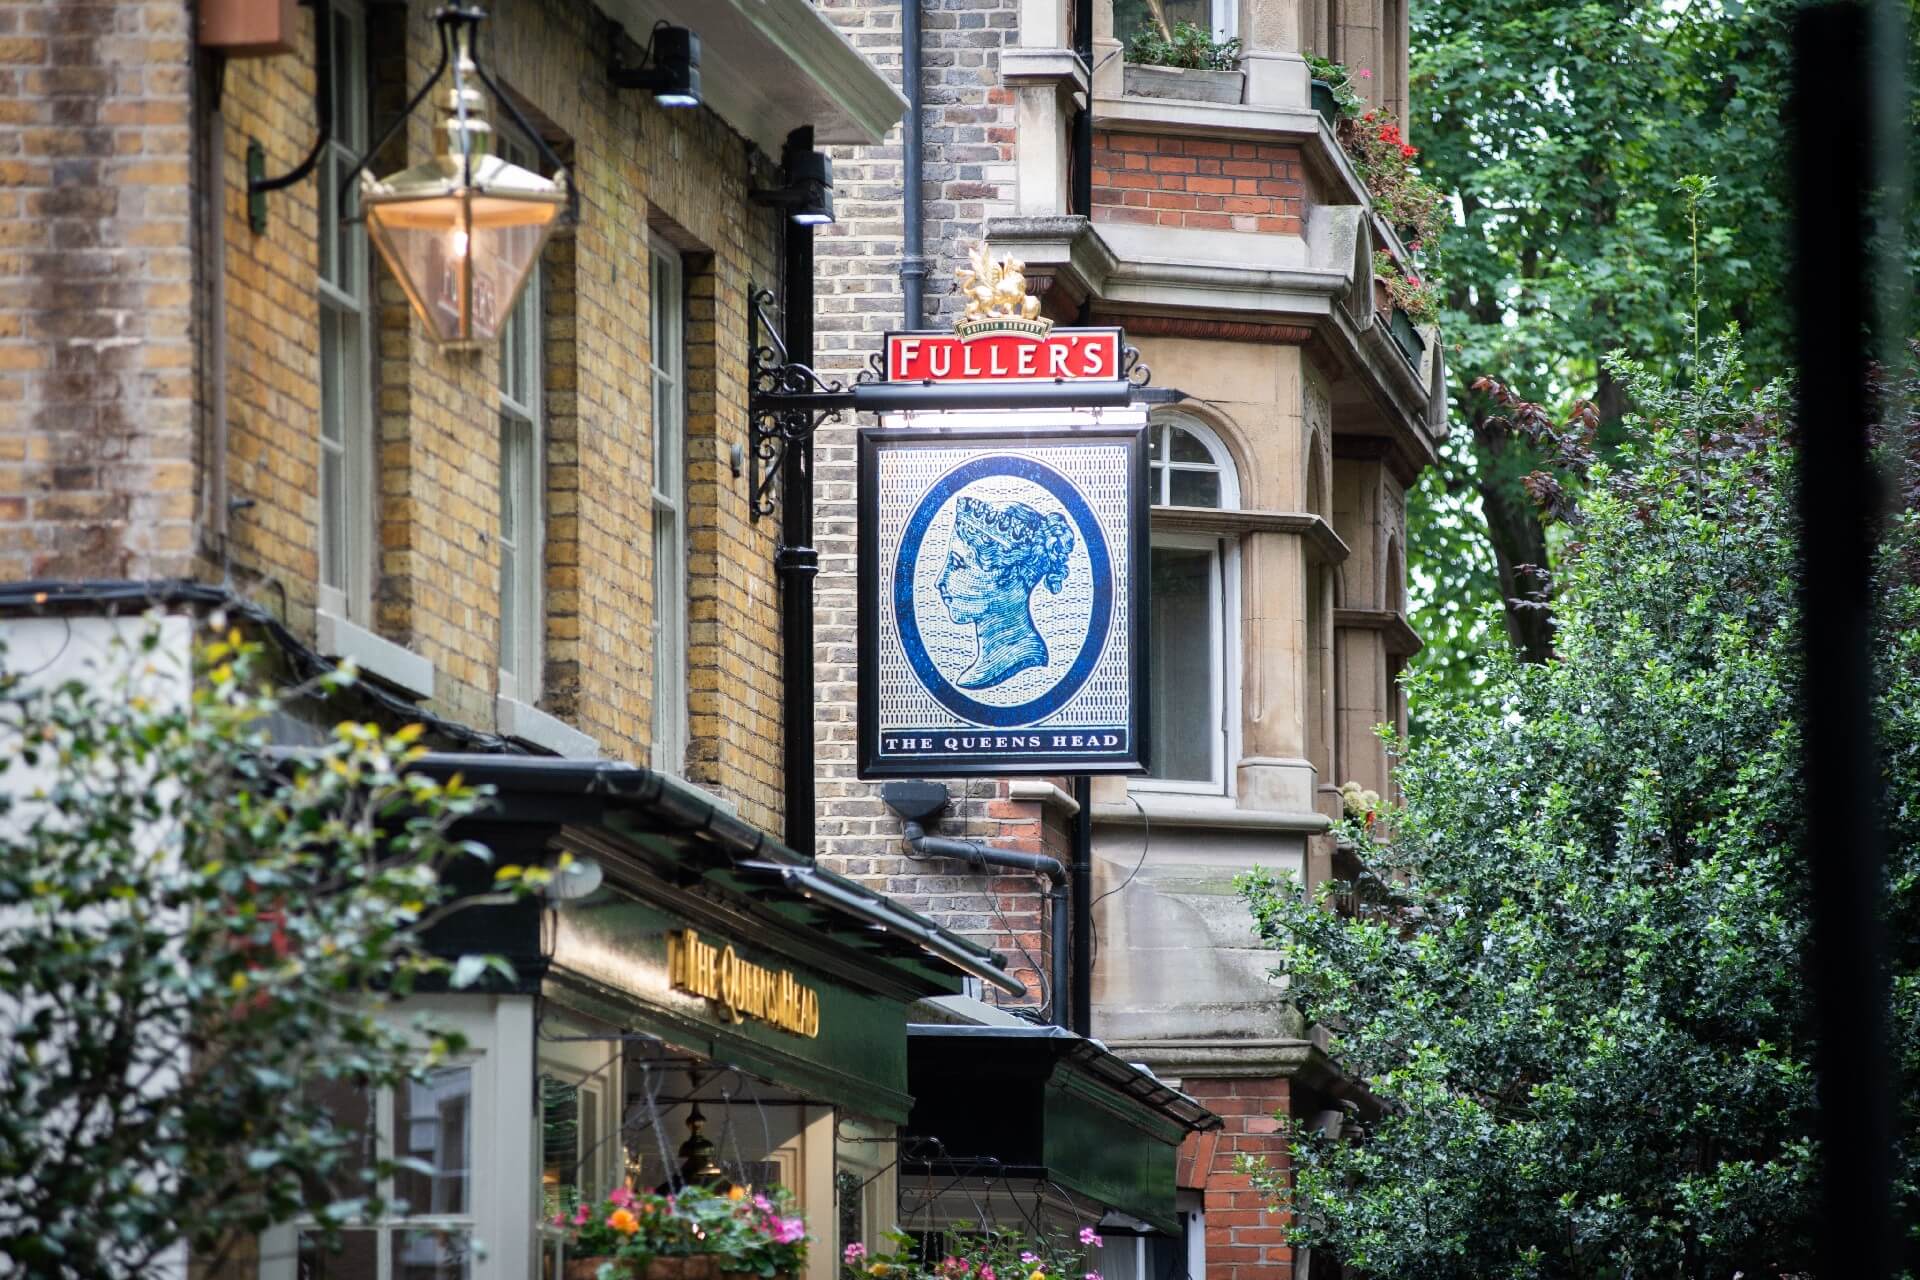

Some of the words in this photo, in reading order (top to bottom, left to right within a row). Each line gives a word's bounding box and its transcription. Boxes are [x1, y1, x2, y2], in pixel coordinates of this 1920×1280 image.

[899, 337, 1104, 378] FULLER'S
[886, 738, 933, 750] THE
[944, 736, 1042, 751] QUEENS
[1052, 735, 1119, 747] HEAD
[677, 928, 718, 1000] THE
[779, 969, 819, 1038] HEAD
